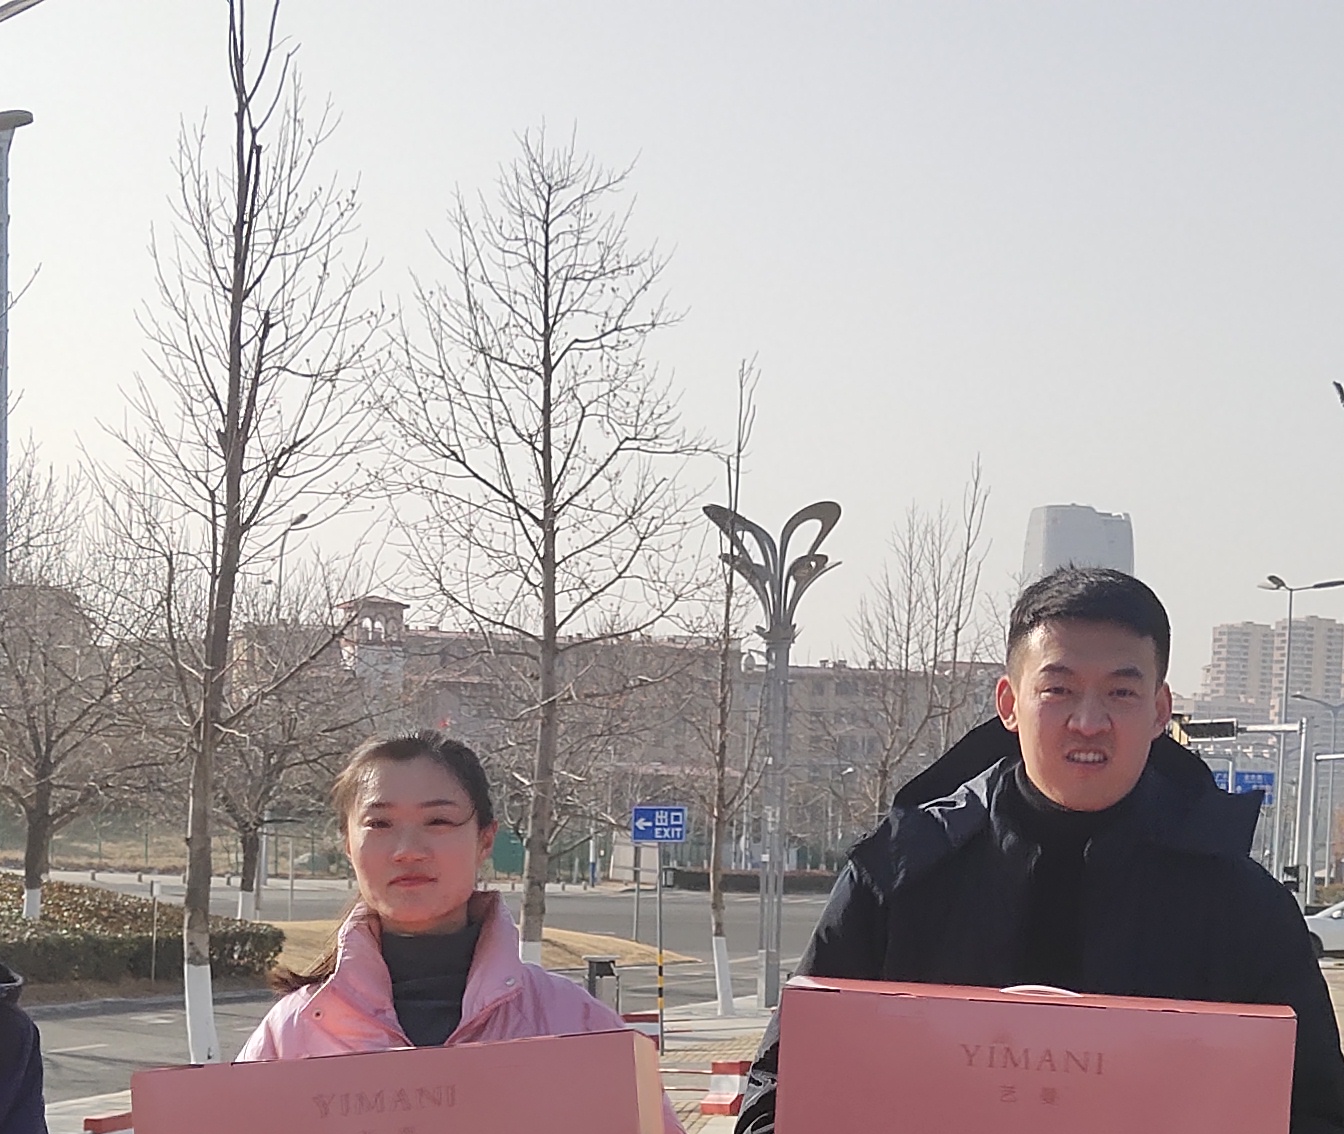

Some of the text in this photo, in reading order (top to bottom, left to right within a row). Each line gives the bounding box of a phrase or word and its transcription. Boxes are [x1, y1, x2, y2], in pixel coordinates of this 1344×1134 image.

[655, 810, 683, 826] 出口
[654, 827, 683, 839] EXIT
[960, 1043, 1104, 1075] YIMANI
[312, 1084, 456, 1118] YIMANI
